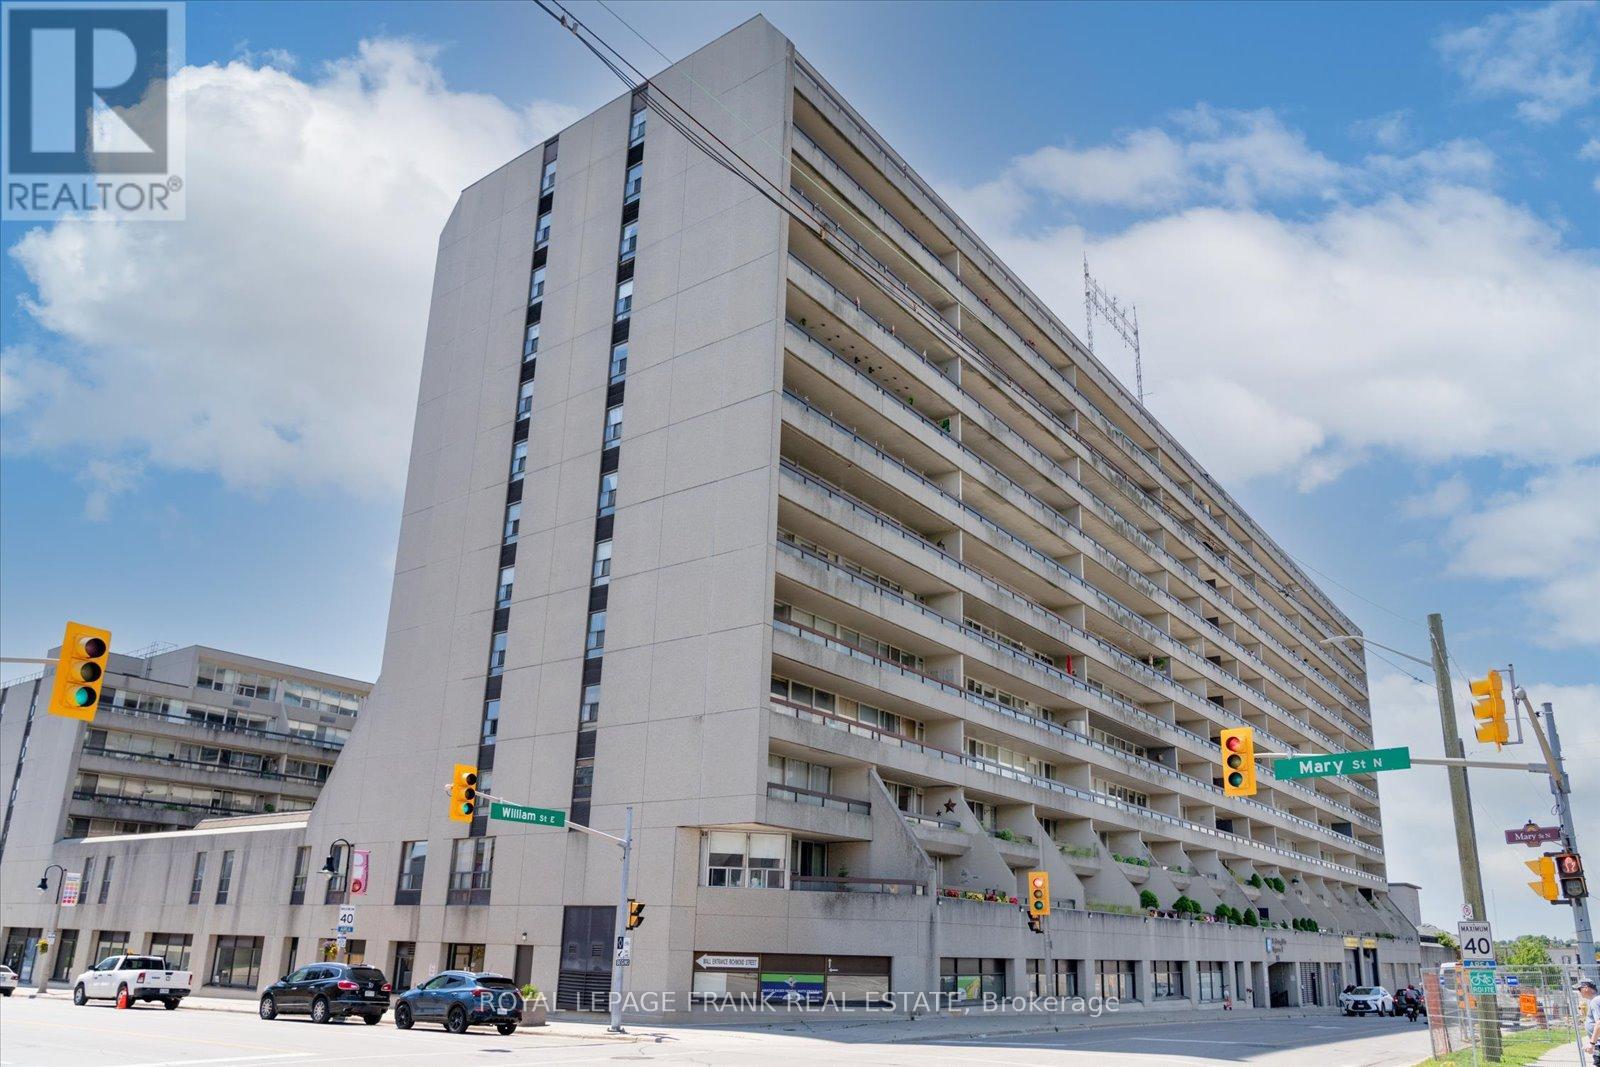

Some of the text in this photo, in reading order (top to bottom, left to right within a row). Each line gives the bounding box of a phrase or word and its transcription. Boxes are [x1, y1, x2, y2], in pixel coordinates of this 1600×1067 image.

[1299, 758, 1383, 775] Mary St N
[502, 807, 556, 824] William St E
[1514, 832, 1537, 841] Mary
[340, 913, 354, 924] 40
[1464, 937, 1490, 955] 40
[1472, 986, 1496, 994] ROUTE
